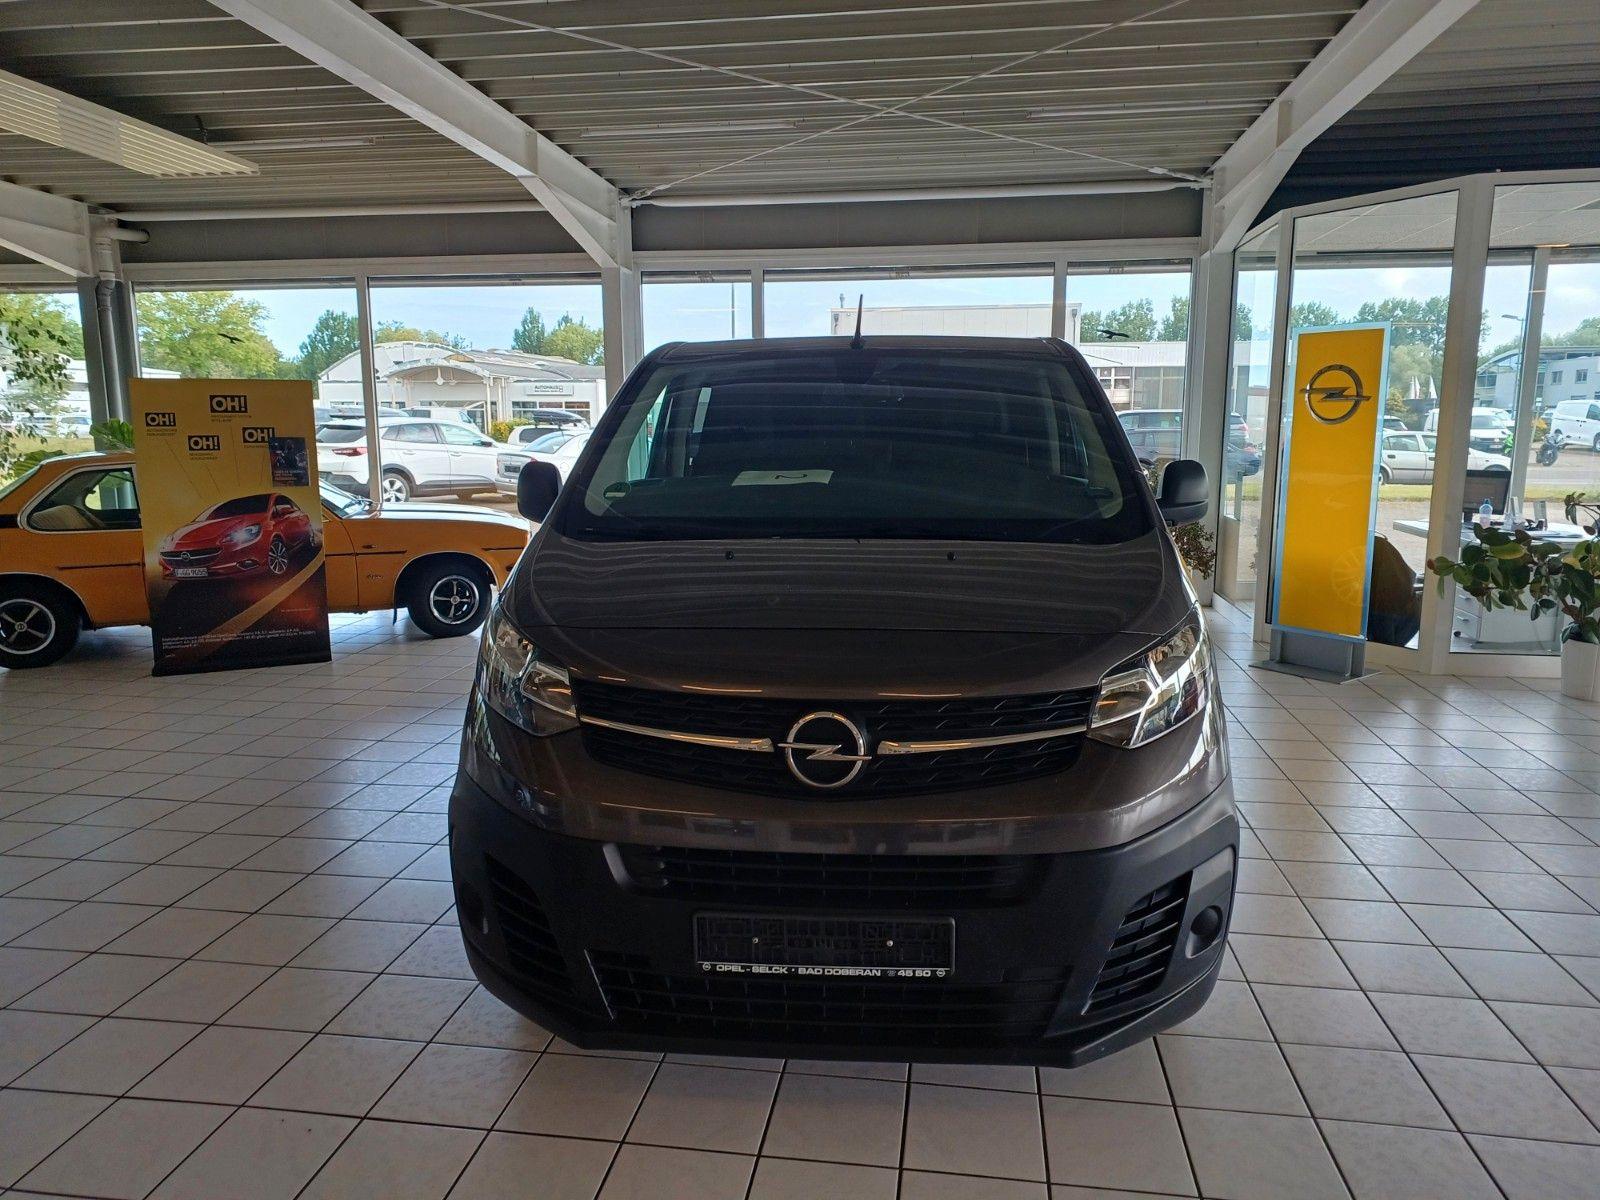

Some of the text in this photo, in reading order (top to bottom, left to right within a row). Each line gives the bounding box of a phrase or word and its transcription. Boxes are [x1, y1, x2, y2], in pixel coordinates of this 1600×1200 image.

[211, 396, 246, 411] OH!
[146, 413, 175, 426] OH!
[244, 428, 273, 442] OH!
[189, 436, 219, 450] OH!
[716, 964, 745, 973] OPEL
[798, 967, 822, 975] BAD
[824, 968, 881, 977] DOBERAN
